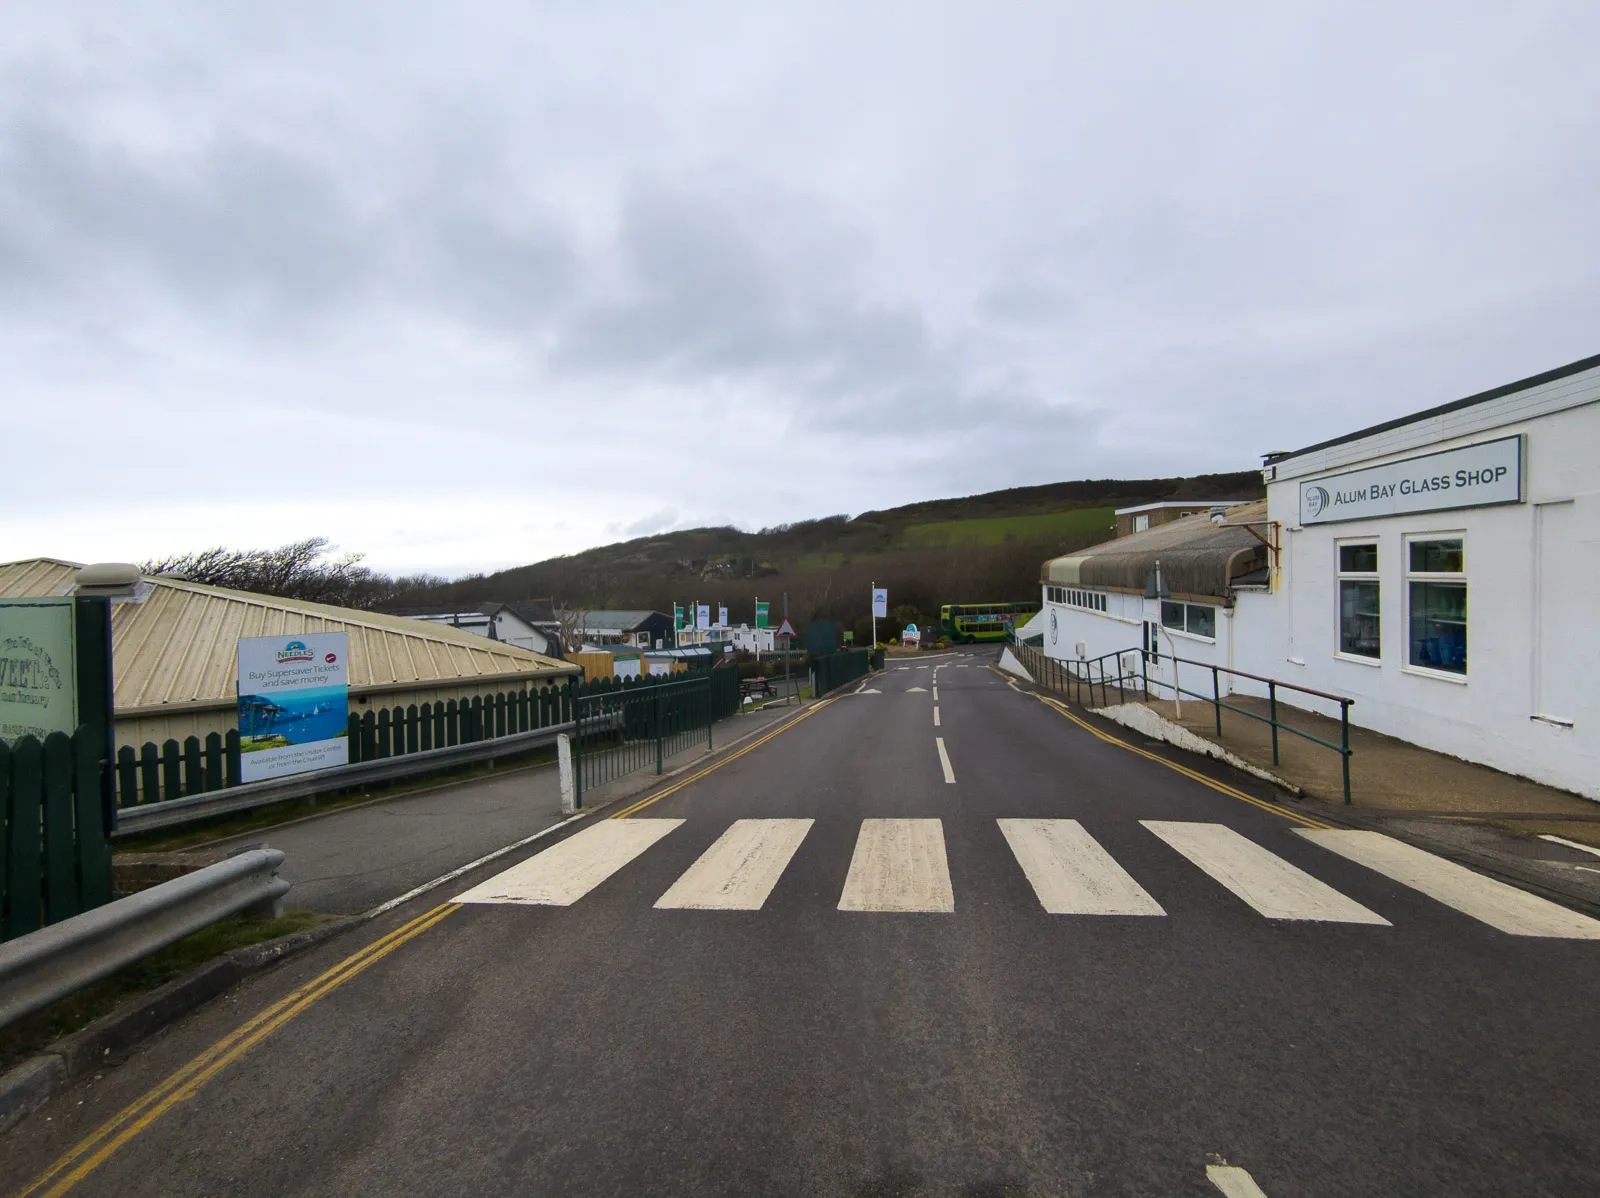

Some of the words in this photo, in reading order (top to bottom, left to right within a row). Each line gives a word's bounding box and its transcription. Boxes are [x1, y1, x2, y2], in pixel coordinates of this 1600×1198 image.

[1334, 489, 1367, 505] ALUM
[1370, 484, 1396, 500] BAY
[1399, 476, 1450, 495] GLASS
[1455, 466, 1507, 488] SHOP
[249, 671, 266, 680] Buy
[267, 667, 312, 679] Supersaver
[313, 664, 340, 673] Tickets
[262, 679, 279, 687] and
[280, 678, 299, 686] save
[300, 675, 329, 684] money
[250, 756, 278, 765] Available
